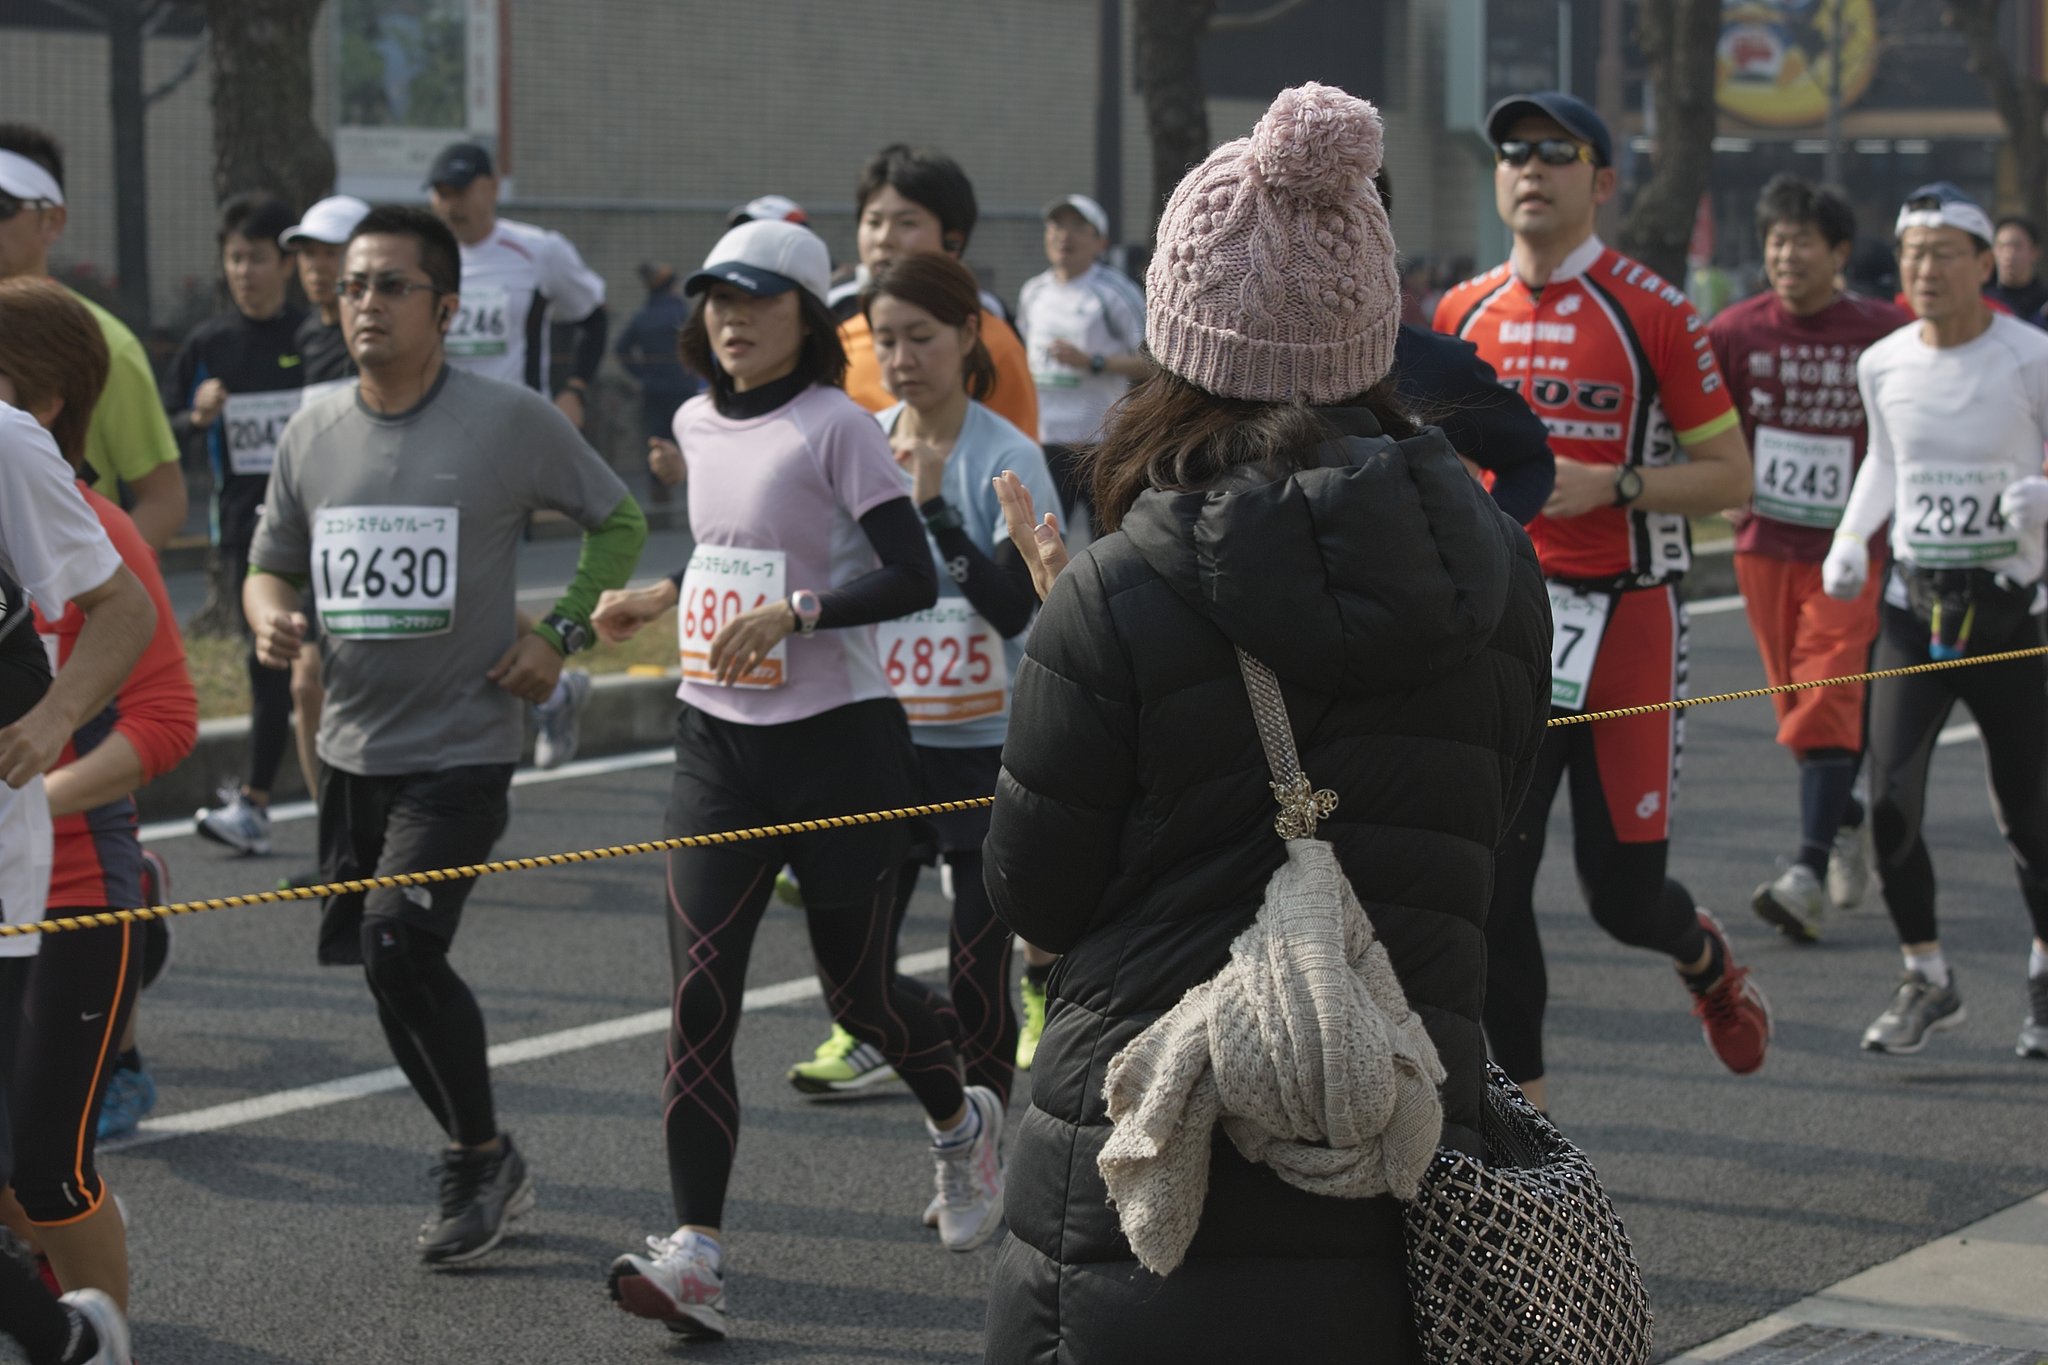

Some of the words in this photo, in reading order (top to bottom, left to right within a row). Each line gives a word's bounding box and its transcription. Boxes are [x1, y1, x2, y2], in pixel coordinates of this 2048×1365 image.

[1609, 258, 1686, 307] TEAM
[1503, 355, 1569, 371] TEAM
[1546, 422, 1615, 438] APAN
[1763, 456, 1841, 500] 4243
[325, 517, 446, 534] エコシステムグループ
[1913, 493, 2006, 536] 2824
[321, 546, 448, 599] 12630
[685, 587, 768, 641] 680
[885, 634, 992, 687] 6825
[1556, 624, 1585, 669] 7
